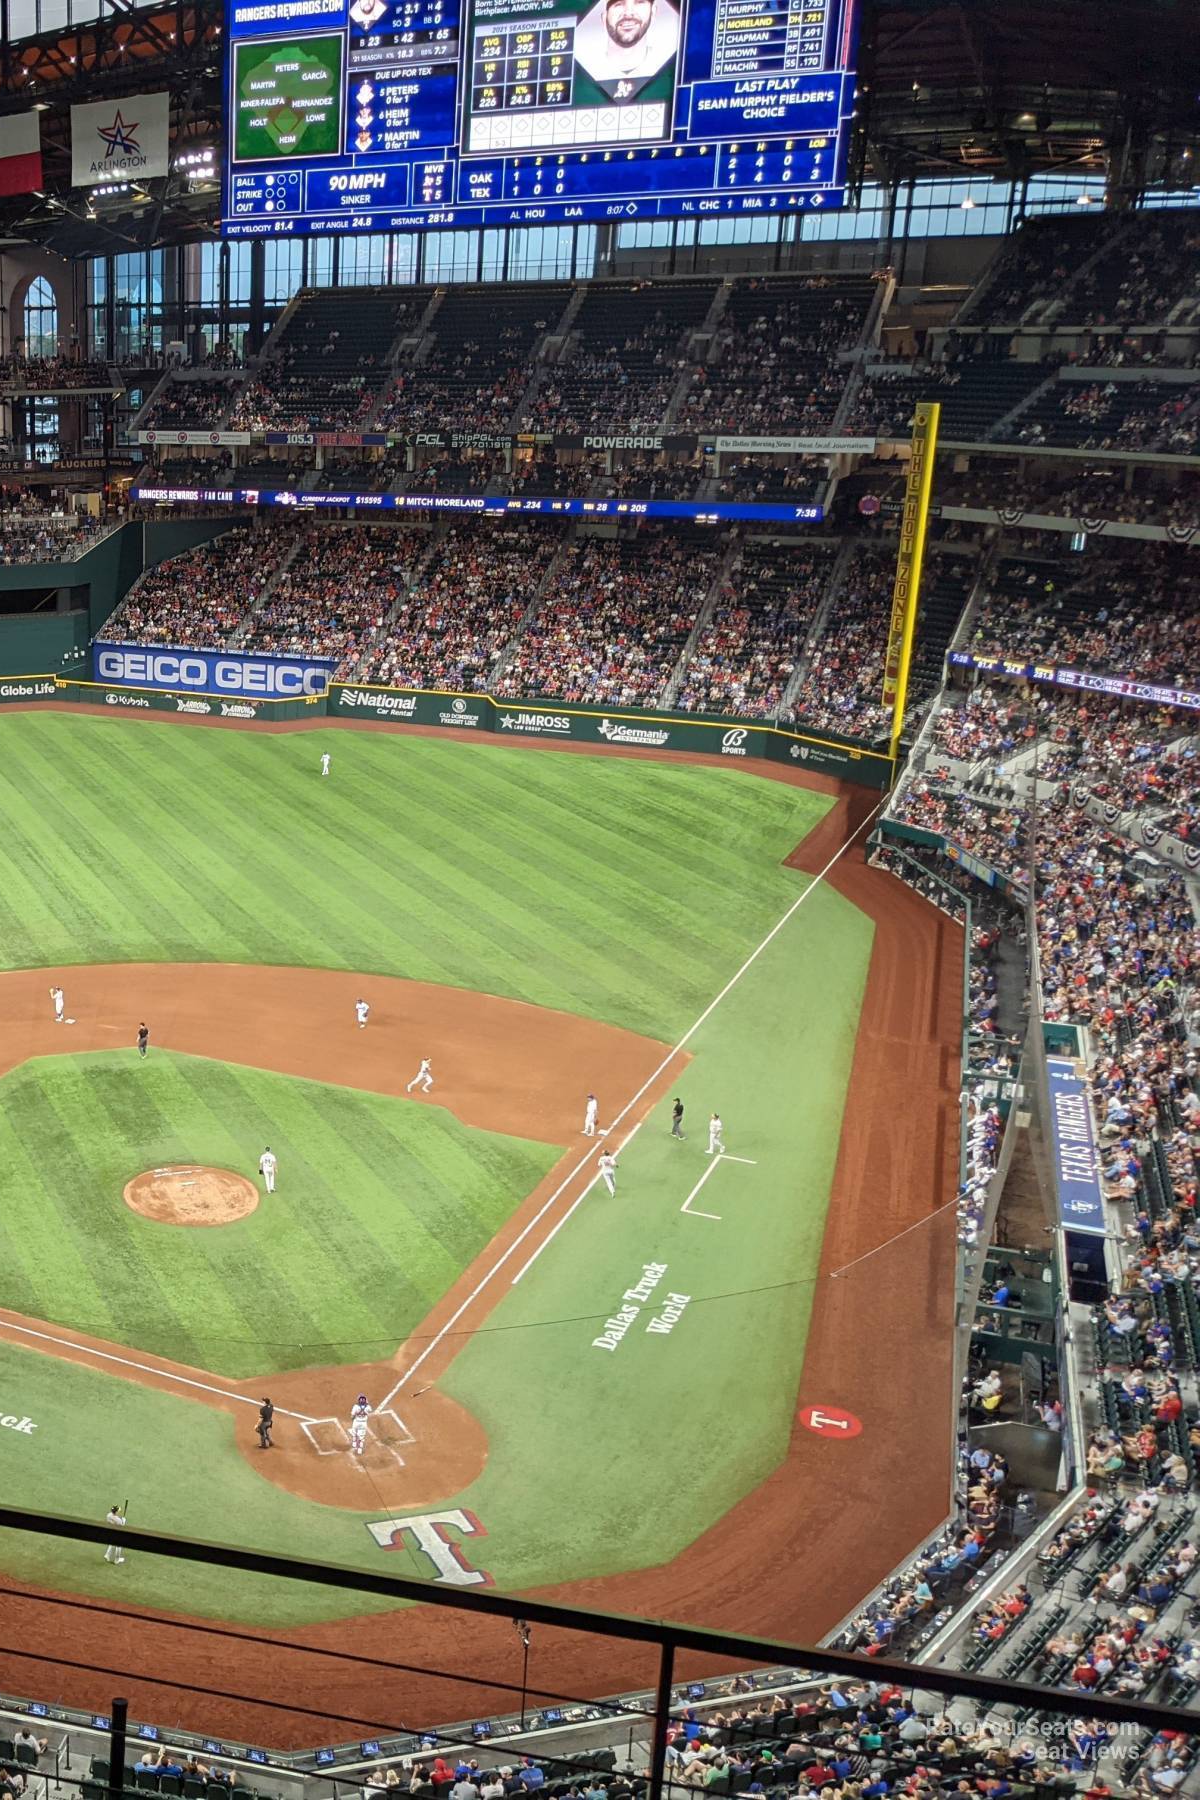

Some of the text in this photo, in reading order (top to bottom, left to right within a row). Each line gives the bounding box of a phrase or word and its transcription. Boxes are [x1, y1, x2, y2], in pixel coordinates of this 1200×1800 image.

[235, 0, 343, 22] RANGERS REWARDS.COM
[728, 4, 764, 14] MURPHY
[509, 23, 536, 32] SEASON
[727, 18, 773, 29] MORELAND
[726, 33, 769, 44] CHAPMAN
[725, 48, 757, 58] BROWN
[275, 63, 299, 72] PETERS
[376, 71, 390, 80] DUE
[391, 70, 401, 79] UP
[402, 69, 416, 77] FOR
[250, 81, 275, 89] MARTIN
[386, 85, 419, 96] PETERS
[735, 78, 799, 93] LAST PLAY
[479, 98, 496, 107] 226
[698, 91, 834, 110] SEAN MURPHY FIELDER'S
[306, 113, 325, 122] LOWE
[385, 109, 409, 118] HEIM
[743, 107, 785, 119] CHOICE
[250, 118, 268, 126] HOLT
[384, 130, 419, 141] MARTIN
[90, 156, 147, 174] ARLINGTON
[237, 178, 255, 186] BALL
[329, 173, 386, 190] 90 MPH
[469, 174, 493, 184] OAK
[237, 190, 262, 199] STRIKE
[470, 188, 490, 198] TEX
[341, 195, 371, 205] SINKER
[699, 198, 762, 210] CHC MIA
[237, 203, 253, 211] OUT
[524, 207, 583, 219] HOU LAA
[391, 213, 454, 225] DISTANCE 281.8
[275, 221, 293, 230] 81.4
[287, 435, 314, 445] 105.3
[416, 434, 446, 445] PGL
[452, 434, 512, 442] ShipPGL.com
[583, 436, 663, 449] POWERADE
[451, 441, 512, 449] 877.701.1919
[720, 440, 791, 449] The Dallas Morning News
[54, 458, 106, 469] PLUCKERS
[908, 438, 925, 490] THE
[139, 489, 199, 501] RANGERS REWARDS
[325, 496, 351, 504] JACKPOT
[406, 498, 485, 508] MITCH MORELAND
[902, 501, 917, 553] HOT
[893, 565, 909, 632] ZONE
[99, 651, 208, 685] GEICO
[215, 661, 332, 695] GEICO
[0, 683, 56, 697] Globe Life
[119, 696, 150, 707] Kubota
[185, 699, 208, 710] ARROW
[357, 691, 416, 710] National
[228, 704, 252, 714] ARROW
[440, 717, 463, 726] FREIGHT
[451, 713, 479, 721] DOMINION
[617, 726, 669, 740] Germania
[620, 736, 659, 744] INSURANCE
[721, 746, 746, 755] SPORTS
[1054, 1091, 1095, 1184] TEXAS RANGERS
[591, 1261, 669, 1352] Dallas Truck
[645, 1292, 692, 1335] World
[810, 1410, 848, 1429] T
[365, 1508, 496, 1587] T
